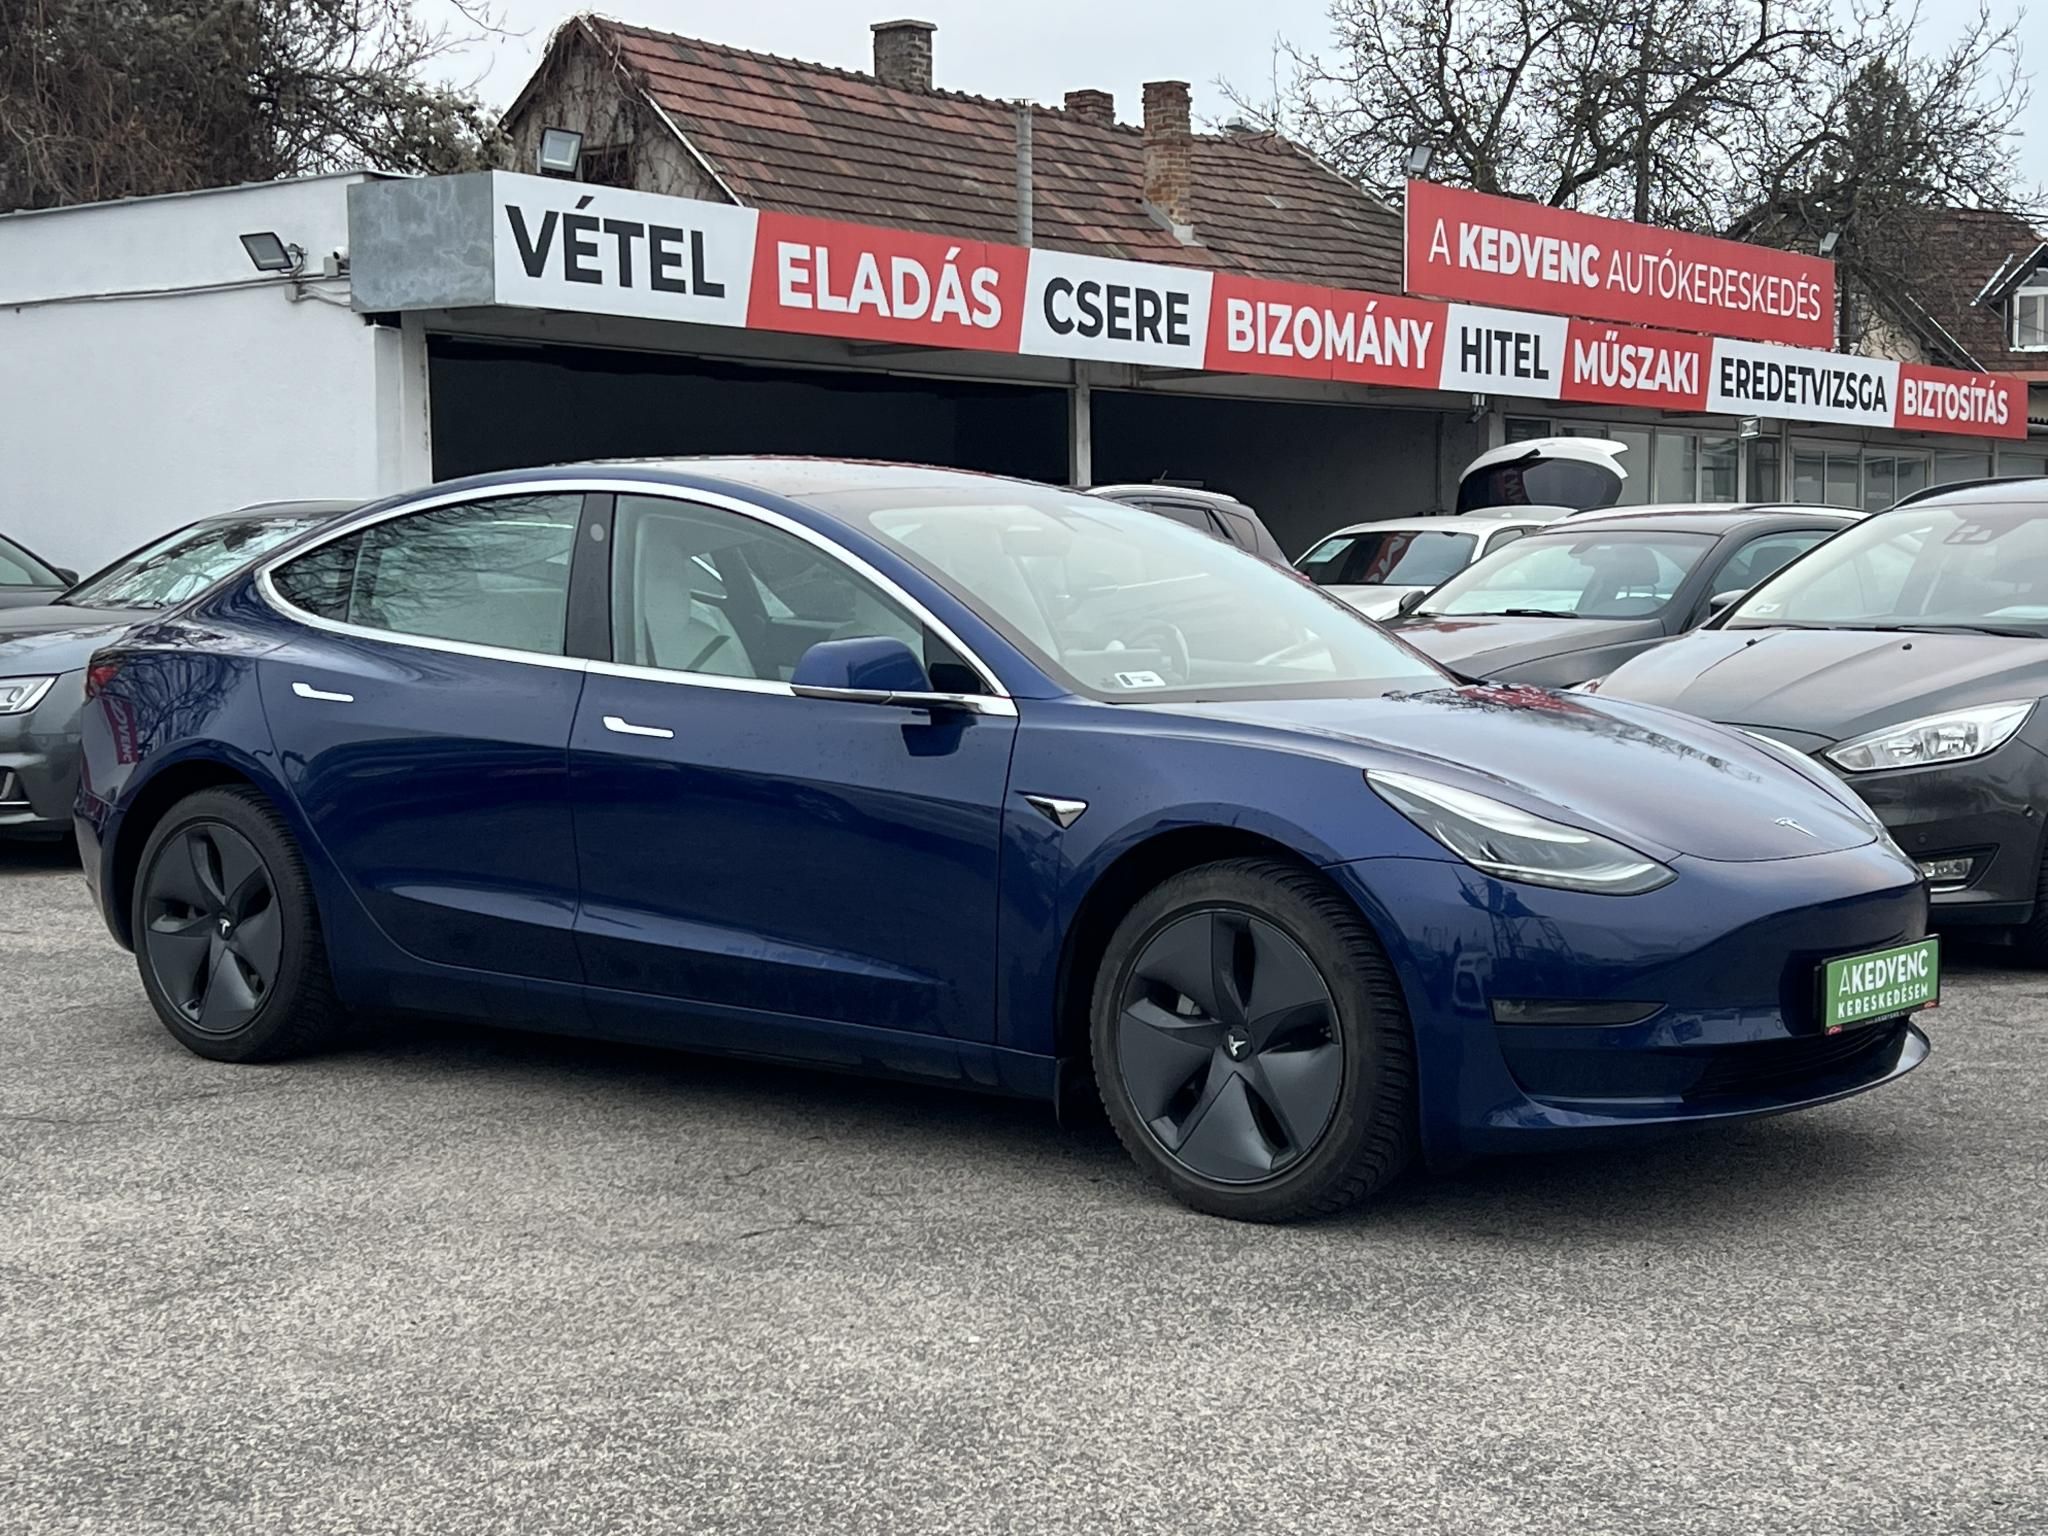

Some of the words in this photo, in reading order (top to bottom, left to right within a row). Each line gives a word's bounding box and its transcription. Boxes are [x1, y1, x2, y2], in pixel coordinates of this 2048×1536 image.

[505, 196, 725, 297] VÉTEL
[1429, 218, 1453, 266] A
[1458, 222, 1600, 288] KEDVENC
[1606, 249, 1821, 321] AUTÓKERESKEDÉS
[776, 241, 1001, 328] ELADÁS
[1043, 276, 1191, 346] CSERE
[1226, 299, 1434, 369] BIZOMÁNY
[1461, 326, 1549, 379] HITEL
[1573, 331, 1699, 393] MŰSZAKI
[1720, 357, 1887, 412] EREDETVIZSGA
[1903, 377, 2008, 425] BIZTOSÍTÁS
[1837, 983, 1928, 1018] KERESKEDÉSEM
